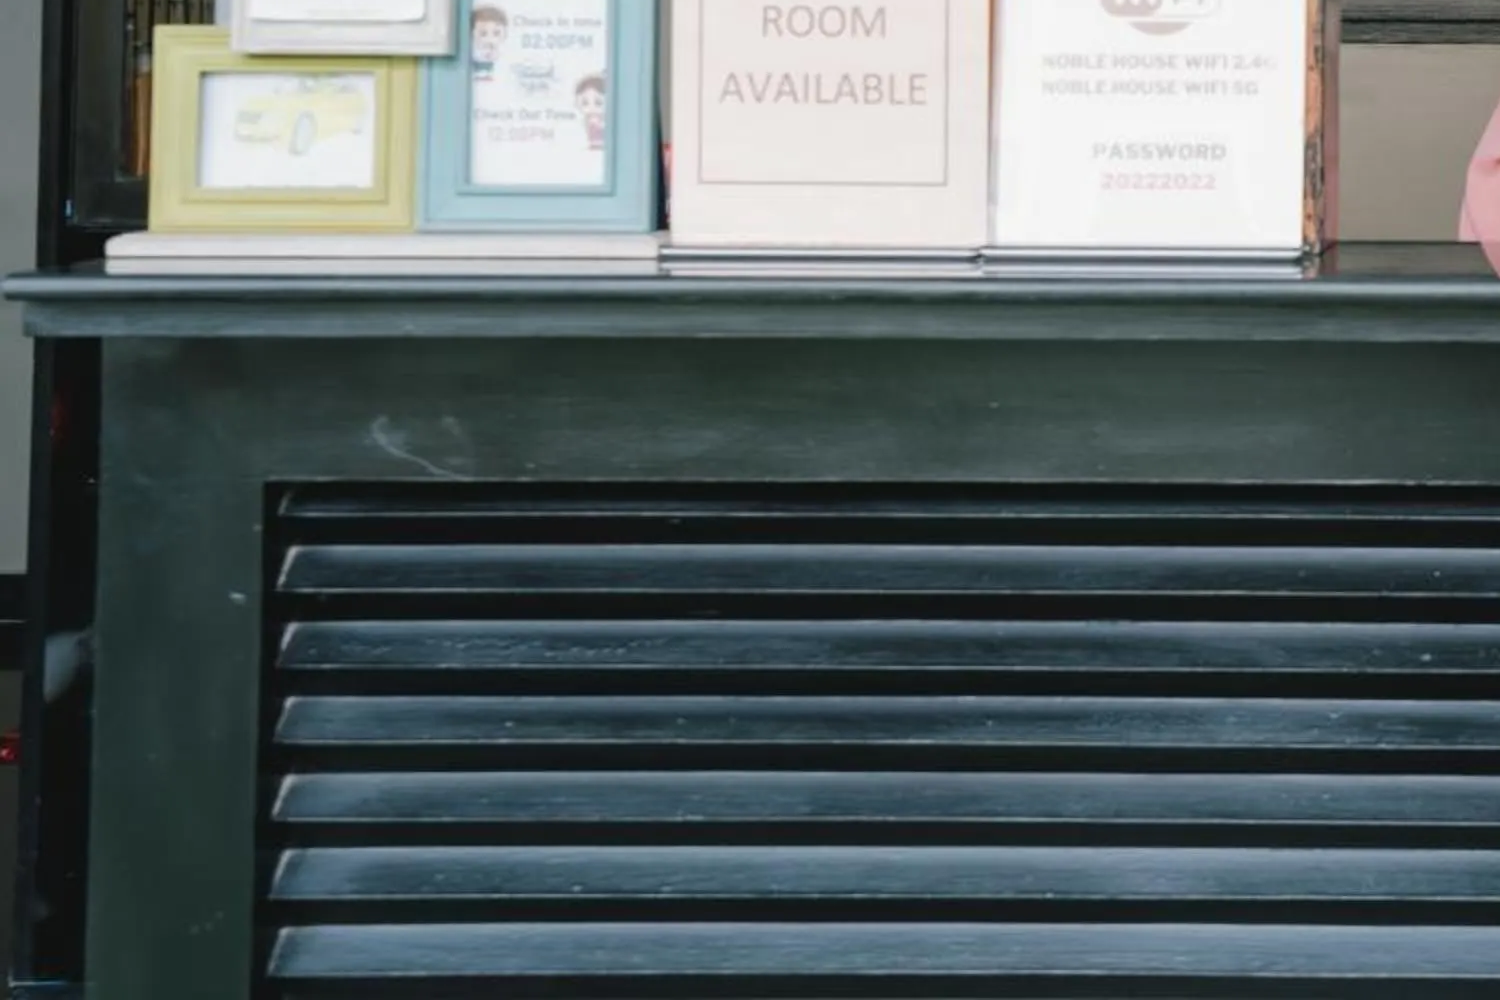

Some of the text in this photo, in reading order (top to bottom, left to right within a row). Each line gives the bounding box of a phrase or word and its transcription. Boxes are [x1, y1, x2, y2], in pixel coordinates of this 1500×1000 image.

[761, 4, 886, 38] ROOM
[1041, 53, 1107, 70] NOBLE
[1111, 53, 1179, 70] HOUSE
[718, 71, 929, 105] AVAILABLE
[1041, 78, 1107, 96] NOBLE
[1111, 78, 1178, 96] HOUSE
[1232, 79, 1260, 96] 5G
[1091, 142, 1228, 161] PASSWORD
[1100, 171, 1218, 191] 20222022
